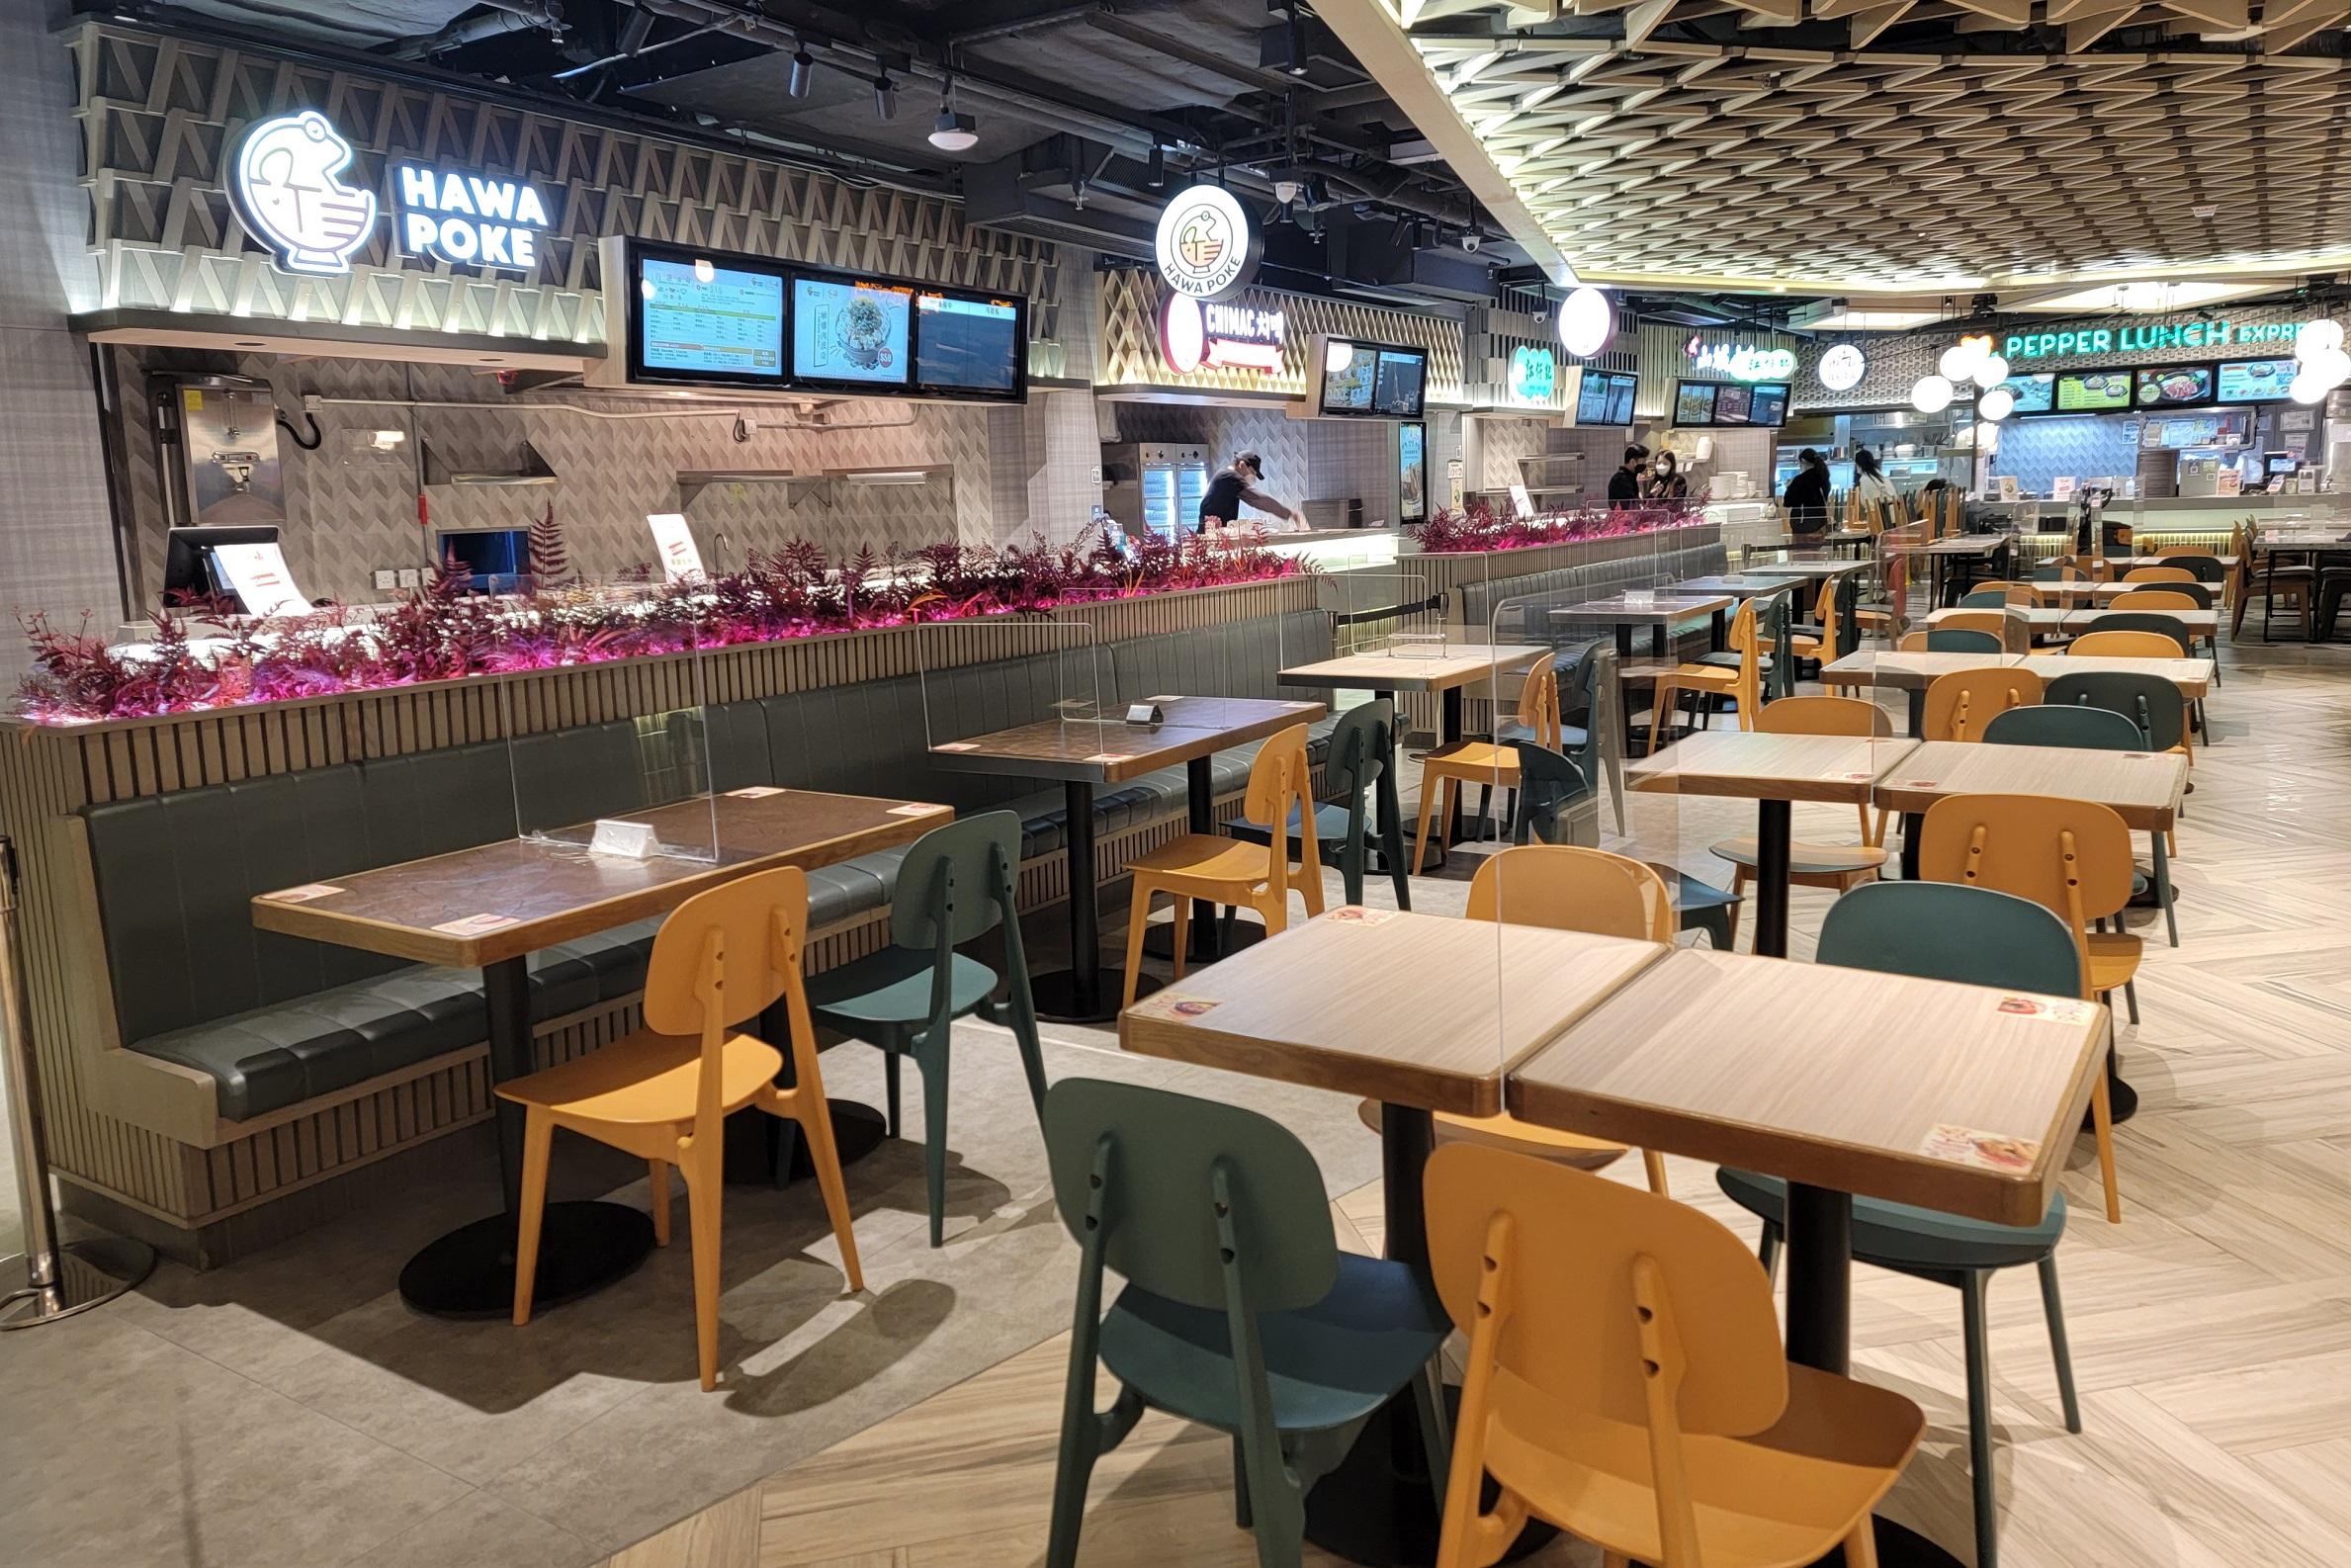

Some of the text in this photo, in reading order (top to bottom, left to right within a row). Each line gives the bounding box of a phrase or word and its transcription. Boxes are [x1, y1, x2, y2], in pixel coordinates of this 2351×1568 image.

[401, 166, 549, 226] HAWA
[406, 213, 536, 266] POKE
[1165, 255, 1241, 294] HAWA POKE
[1206, 304, 1255, 338] CHIMAC
[2005, 330, 2112, 359] PEPPER
[2119, 320, 2229, 351] LUNCH
